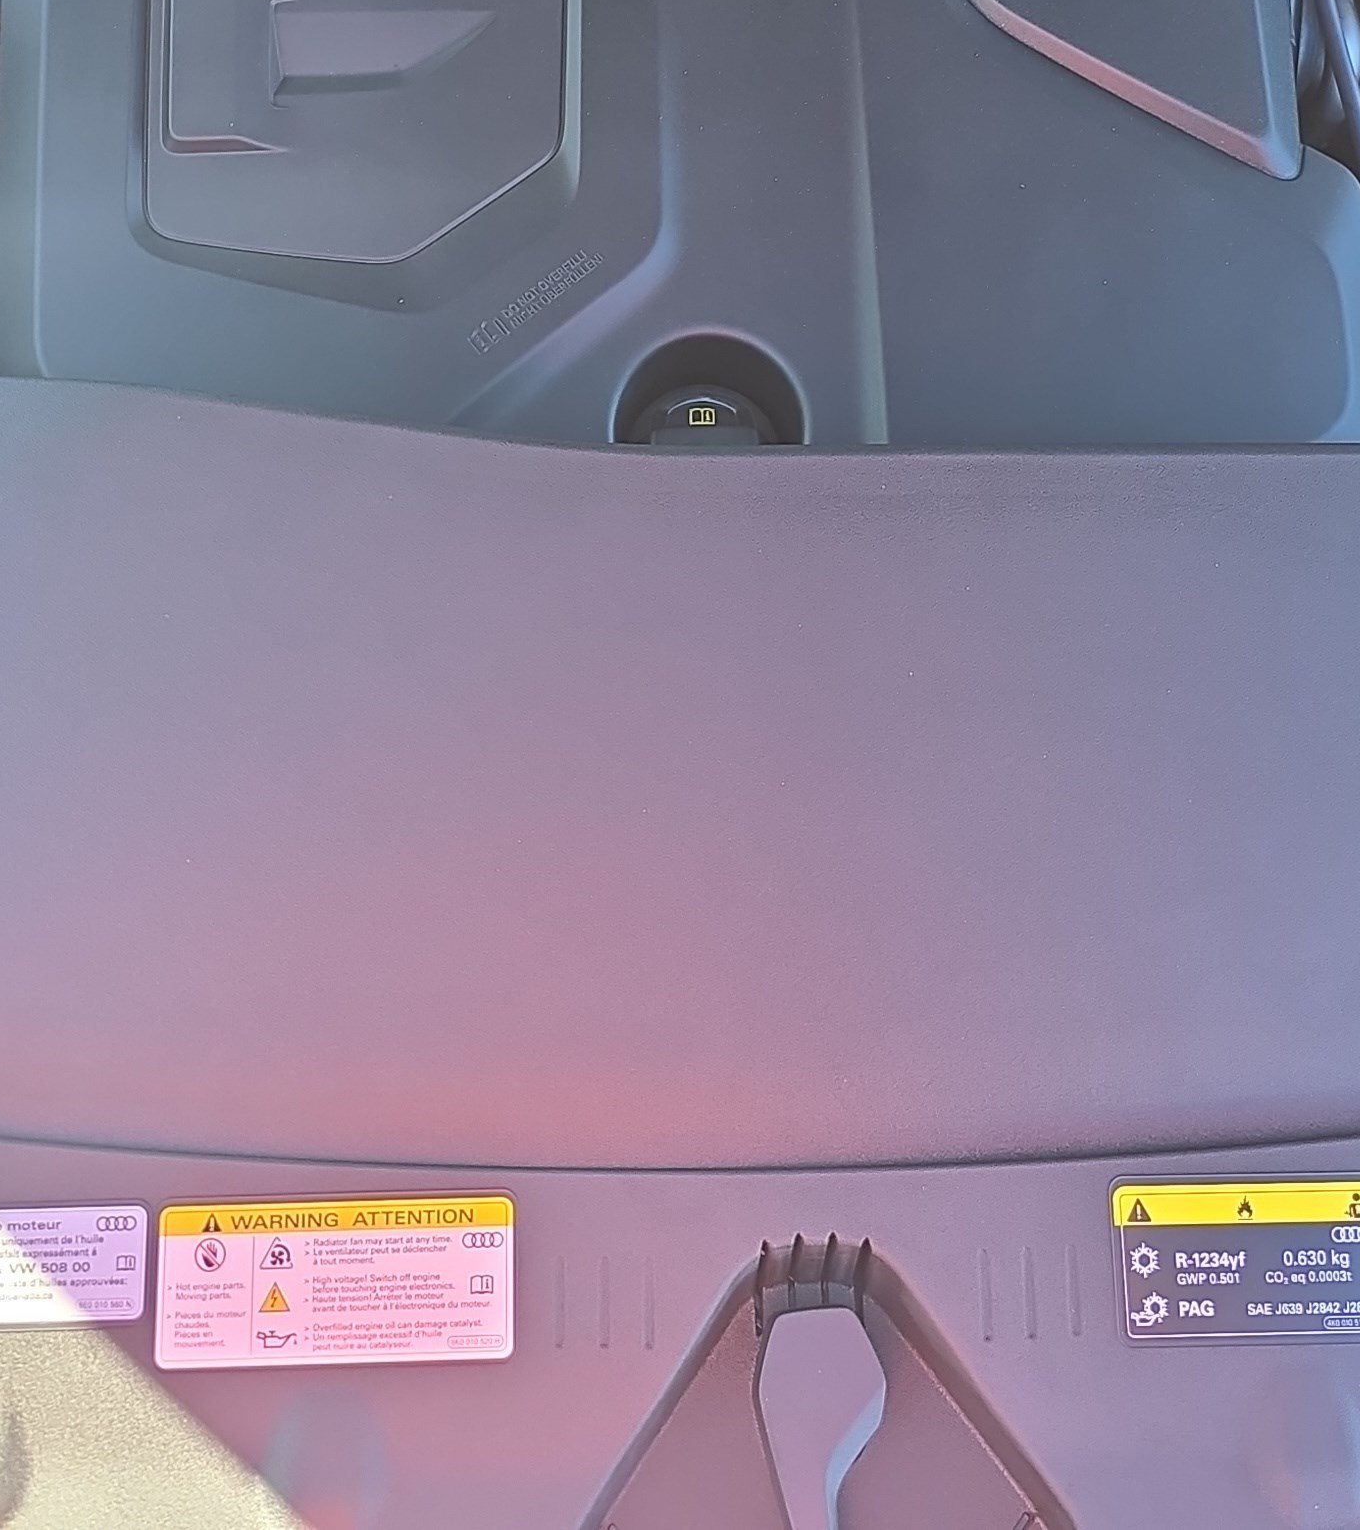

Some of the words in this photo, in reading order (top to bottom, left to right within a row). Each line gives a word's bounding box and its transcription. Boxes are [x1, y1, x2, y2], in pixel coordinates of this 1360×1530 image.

[501, 303, 519, 319] DO
[516, 286, 540, 307] NOT
[230, 1212, 339, 1230] WARNING
[352, 1208, 475, 1227] ATTENTION
[6, 1220, 63, 1232] moteur
[1, 1236, 59, 1247] uniquement
[60, 1235, 73, 1245] de
[313, 1237, 348, 1247] Radiator
[350, 1237, 364, 1246] fan
[365, 1238, 383, 1247] may
[384, 1236, 404, 1245] start
[405, 1236, 418, 1245] at
[420, 1236, 430, 1245] any
[432, 1235, 453, 1244] time.
[22, 1248, 90, 1259] expressément
[313, 1247, 323, 1256] Le
[324, 1247, 369, 1257] ventilateur
[370, 1247, 390, 1257] peut
[402, 1244, 447, 1254] déclencher
[312, 1257, 319, 1266] à
[320, 1257, 337, 1266] tout
[338, 1257, 376, 1265] moment.
[1174, 1250, 1247, 1271] R-1234yf
[1283, 1250, 1327, 1267] 0.630
[1330, 1249, 1351, 1269] kg
[9, 1262, 37, 1274] VW
[40, 1261, 68, 1274] 508
[72, 1261, 91, 1273] 00
[312, 1275, 332, 1286] High
[333, 1274, 368, 1285] voltage!
[369, 1273, 398, 1283] Switch
[399, 1273, 411, 1282] off
[412, 1273, 441, 1283] engine
[1176, 1272, 1207, 1285] GWP
[1208, 1272, 1240, 1285] 0.501
[1290, 1272, 1306, 1285] eq
[1308, 1270, 1353, 1284] 0.0003t
[175, 1282, 191, 1291] Hot
[192, 1283, 221, 1292] engine
[223, 1282, 246, 1291] parts.
[312, 1284, 339, 1294] before
[340, 1283, 377, 1294] touching
[379, 1284, 408, 1294] engine
[409, 1282, 455, 1292] electronics.
[175, 1292, 207, 1302] Moving
[208, 1292, 232, 1301] parts.
[312, 1294, 337, 1303] Haute
[338, 1293, 373, 1302] tension!
[404, 1292, 413, 1300] le
[414, 1292, 444, 1300] moteur
[312, 1304, 336, 1313] avant
[337, 1303, 347, 1312] de
[349, 1302, 381, 1312] toucher
[382, 1300, 388, 1310] à
[447, 1299, 459, 1309] du
[460, 1300, 491, 1308] moteur.
[1178, 1300, 1215, 1318] PAG
[1247, 1302, 1273, 1316] SAE
[1275, 1302, 1304, 1316] J639
[1305, 1301, 1341, 1315] J2842
[203, 1310, 214, 1319] du
[174, 1321, 211, 1329] chaudes.
[312, 1322, 353, 1332] Overfilled
[354, 1322, 383, 1333] engine
[384, 1321, 396, 1330] oil
[397, 1321, 412, 1330] can
[414, 1319, 447, 1330] damage
[449, 1318, 483, 1329] catalyst.
[312, 1332, 325, 1341] Un
[326, 1331, 378, 1343] remplissage
[379, 1330, 412, 1340] excessif
[174, 1339, 226, 1349] mouvement.
[312, 1343, 332, 1352] peut
[332, 1341, 354, 1350] nuire
[357, 1342, 368, 1350] au
